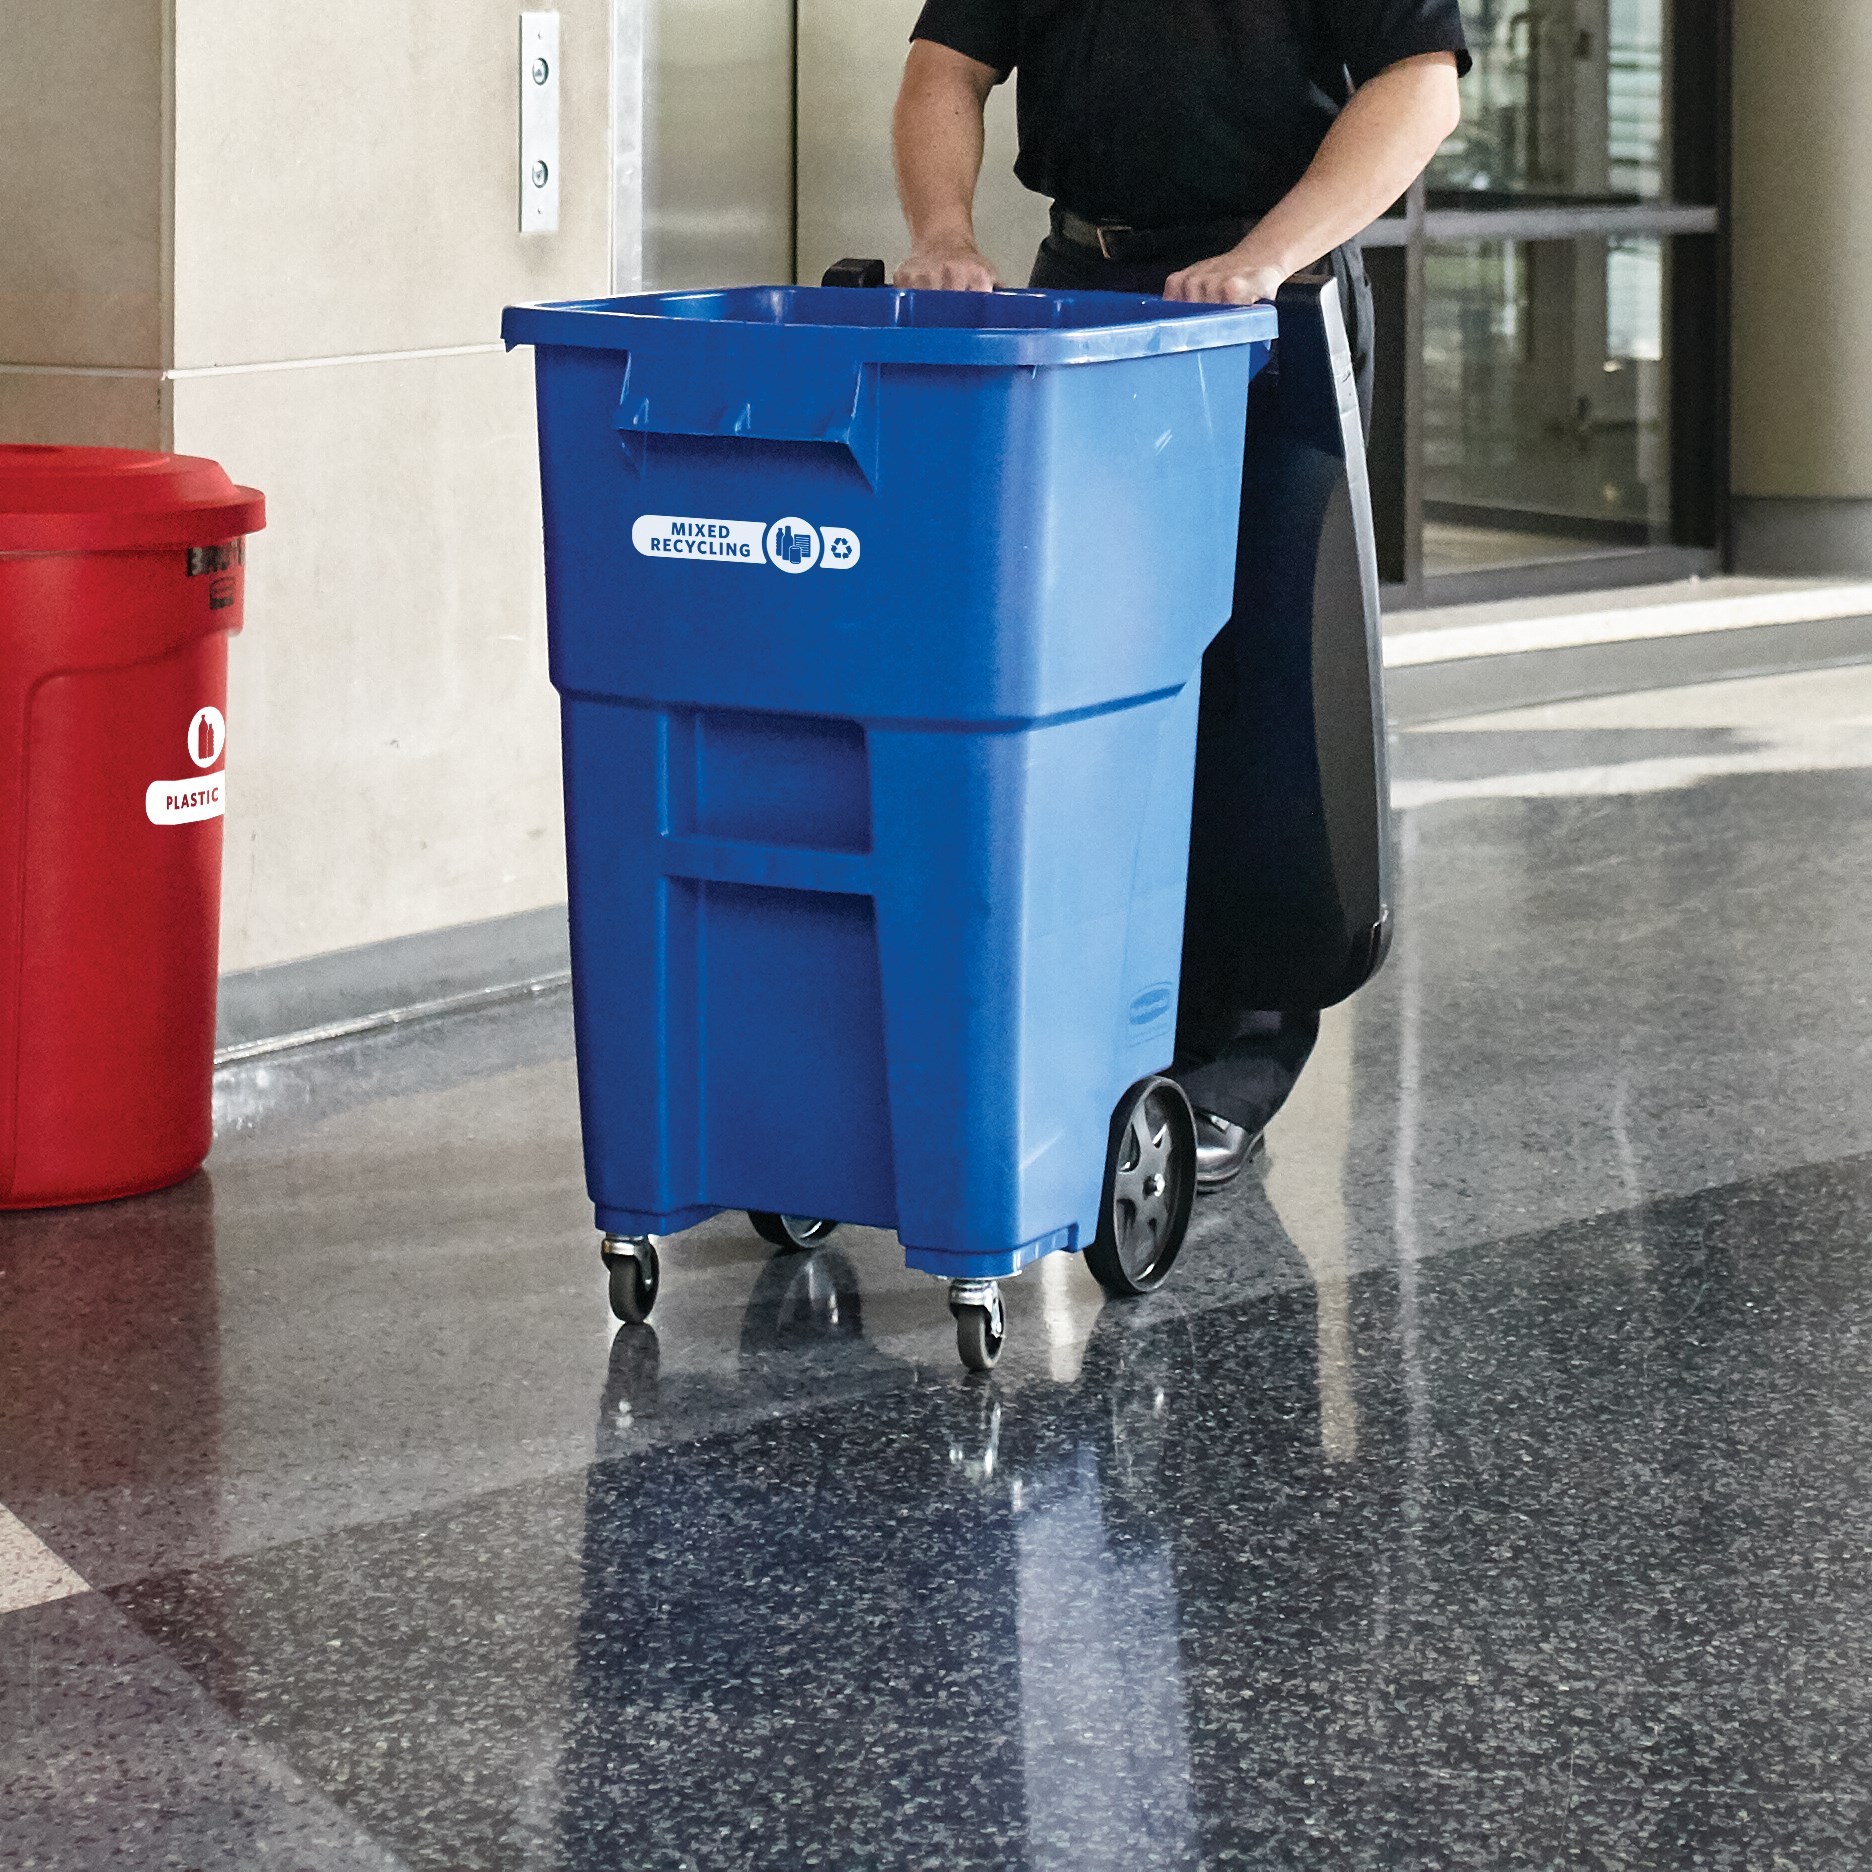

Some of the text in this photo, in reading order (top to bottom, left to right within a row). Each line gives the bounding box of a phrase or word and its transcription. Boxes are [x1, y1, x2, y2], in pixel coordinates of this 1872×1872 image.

[671, 522, 730, 539] MIXED
[651, 537, 751, 558] RECYCLING
[166, 787, 219, 810] PLASTIC
